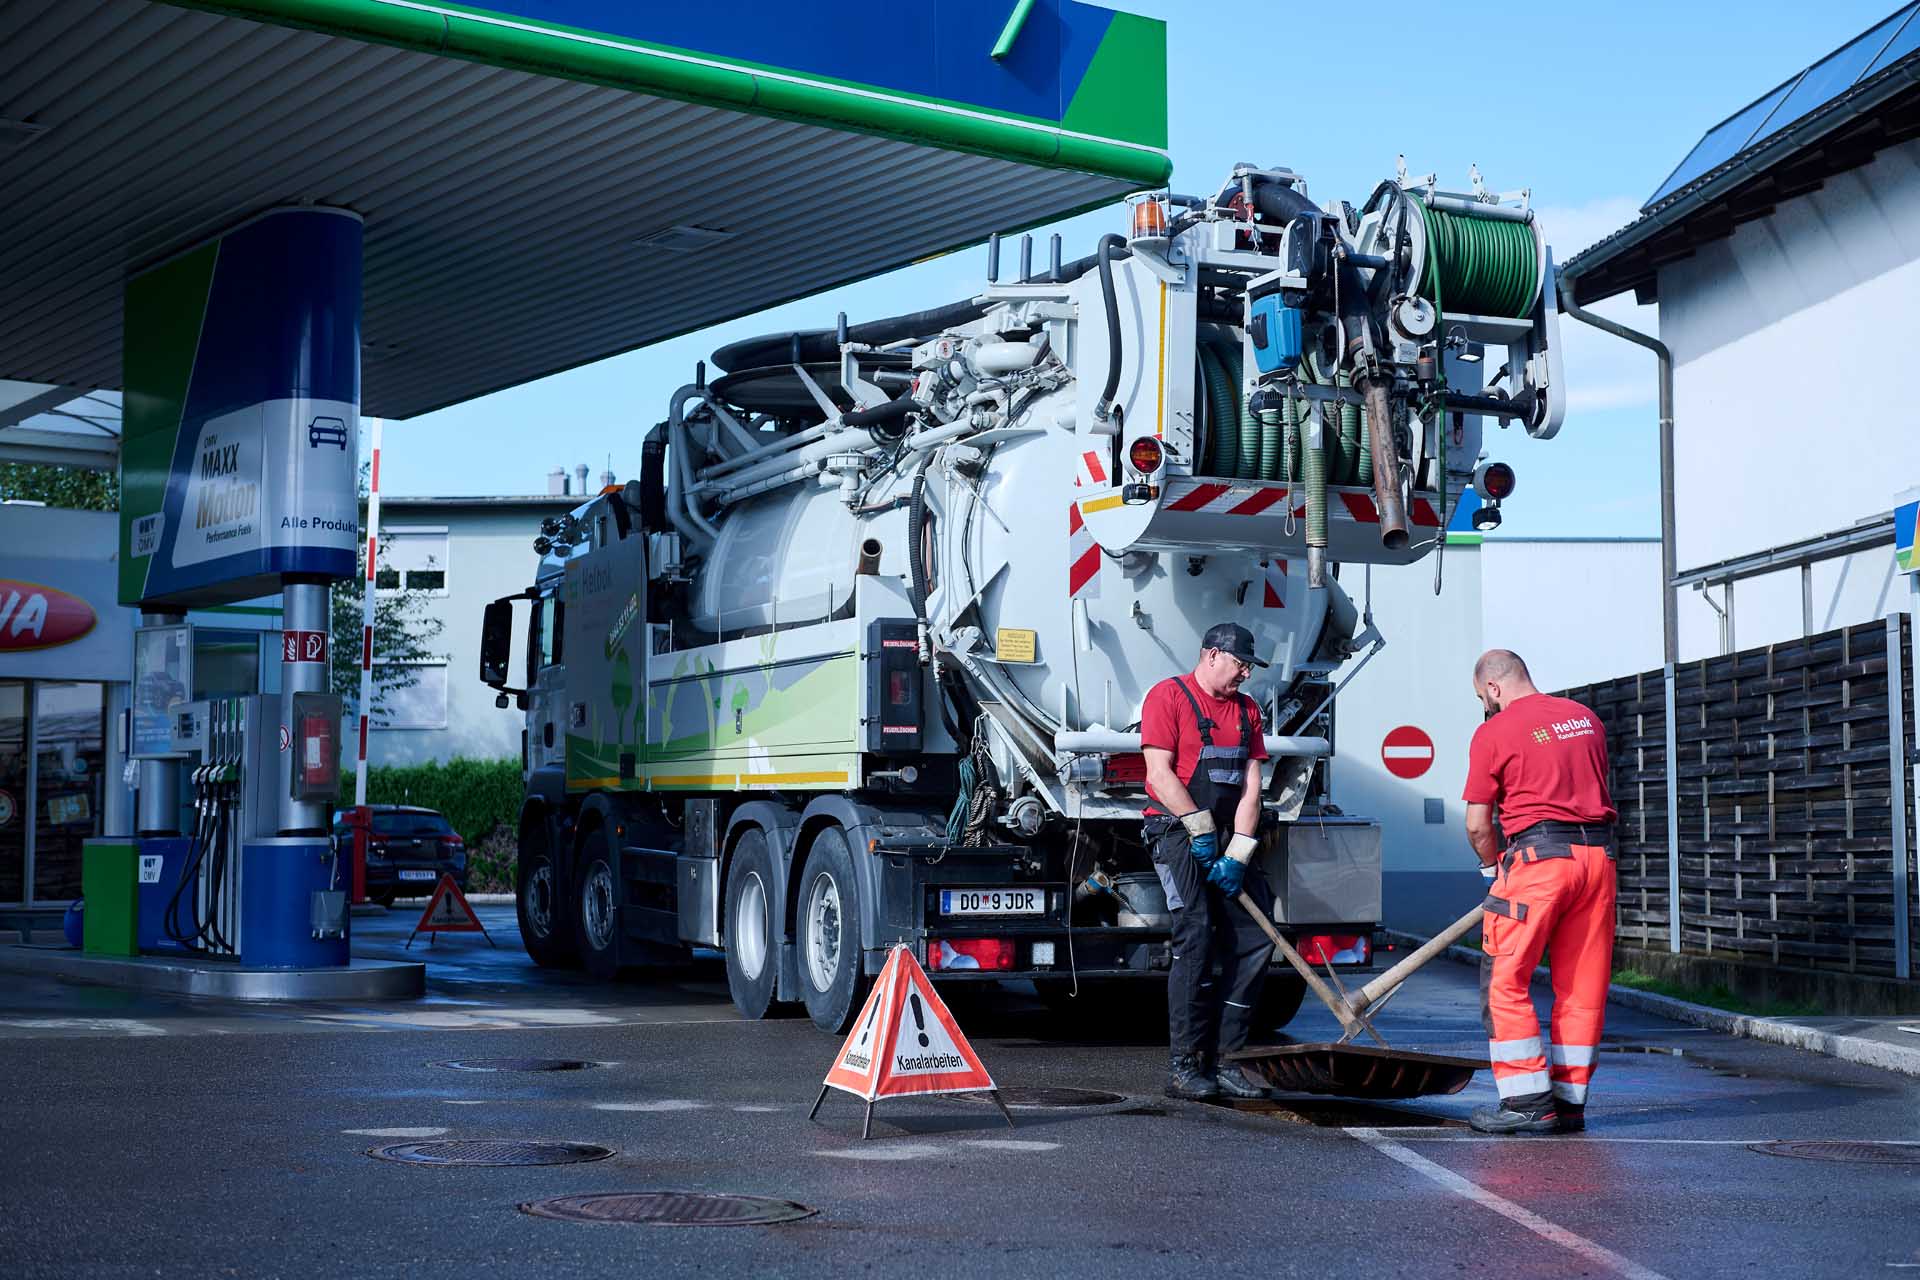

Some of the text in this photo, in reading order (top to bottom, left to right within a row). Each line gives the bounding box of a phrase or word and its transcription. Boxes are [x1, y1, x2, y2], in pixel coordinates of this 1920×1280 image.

[202, 443, 239, 480] MAXX
[196, 477, 256, 529] Motion
[281, 517, 308, 528] Alle
[206, 523, 252, 544] Performance Fuels
[1552, 717, 1592, 733] Helbok
[961, 893, 980, 911] DO
[897, 1053, 963, 1071] Kanalarbeiten
